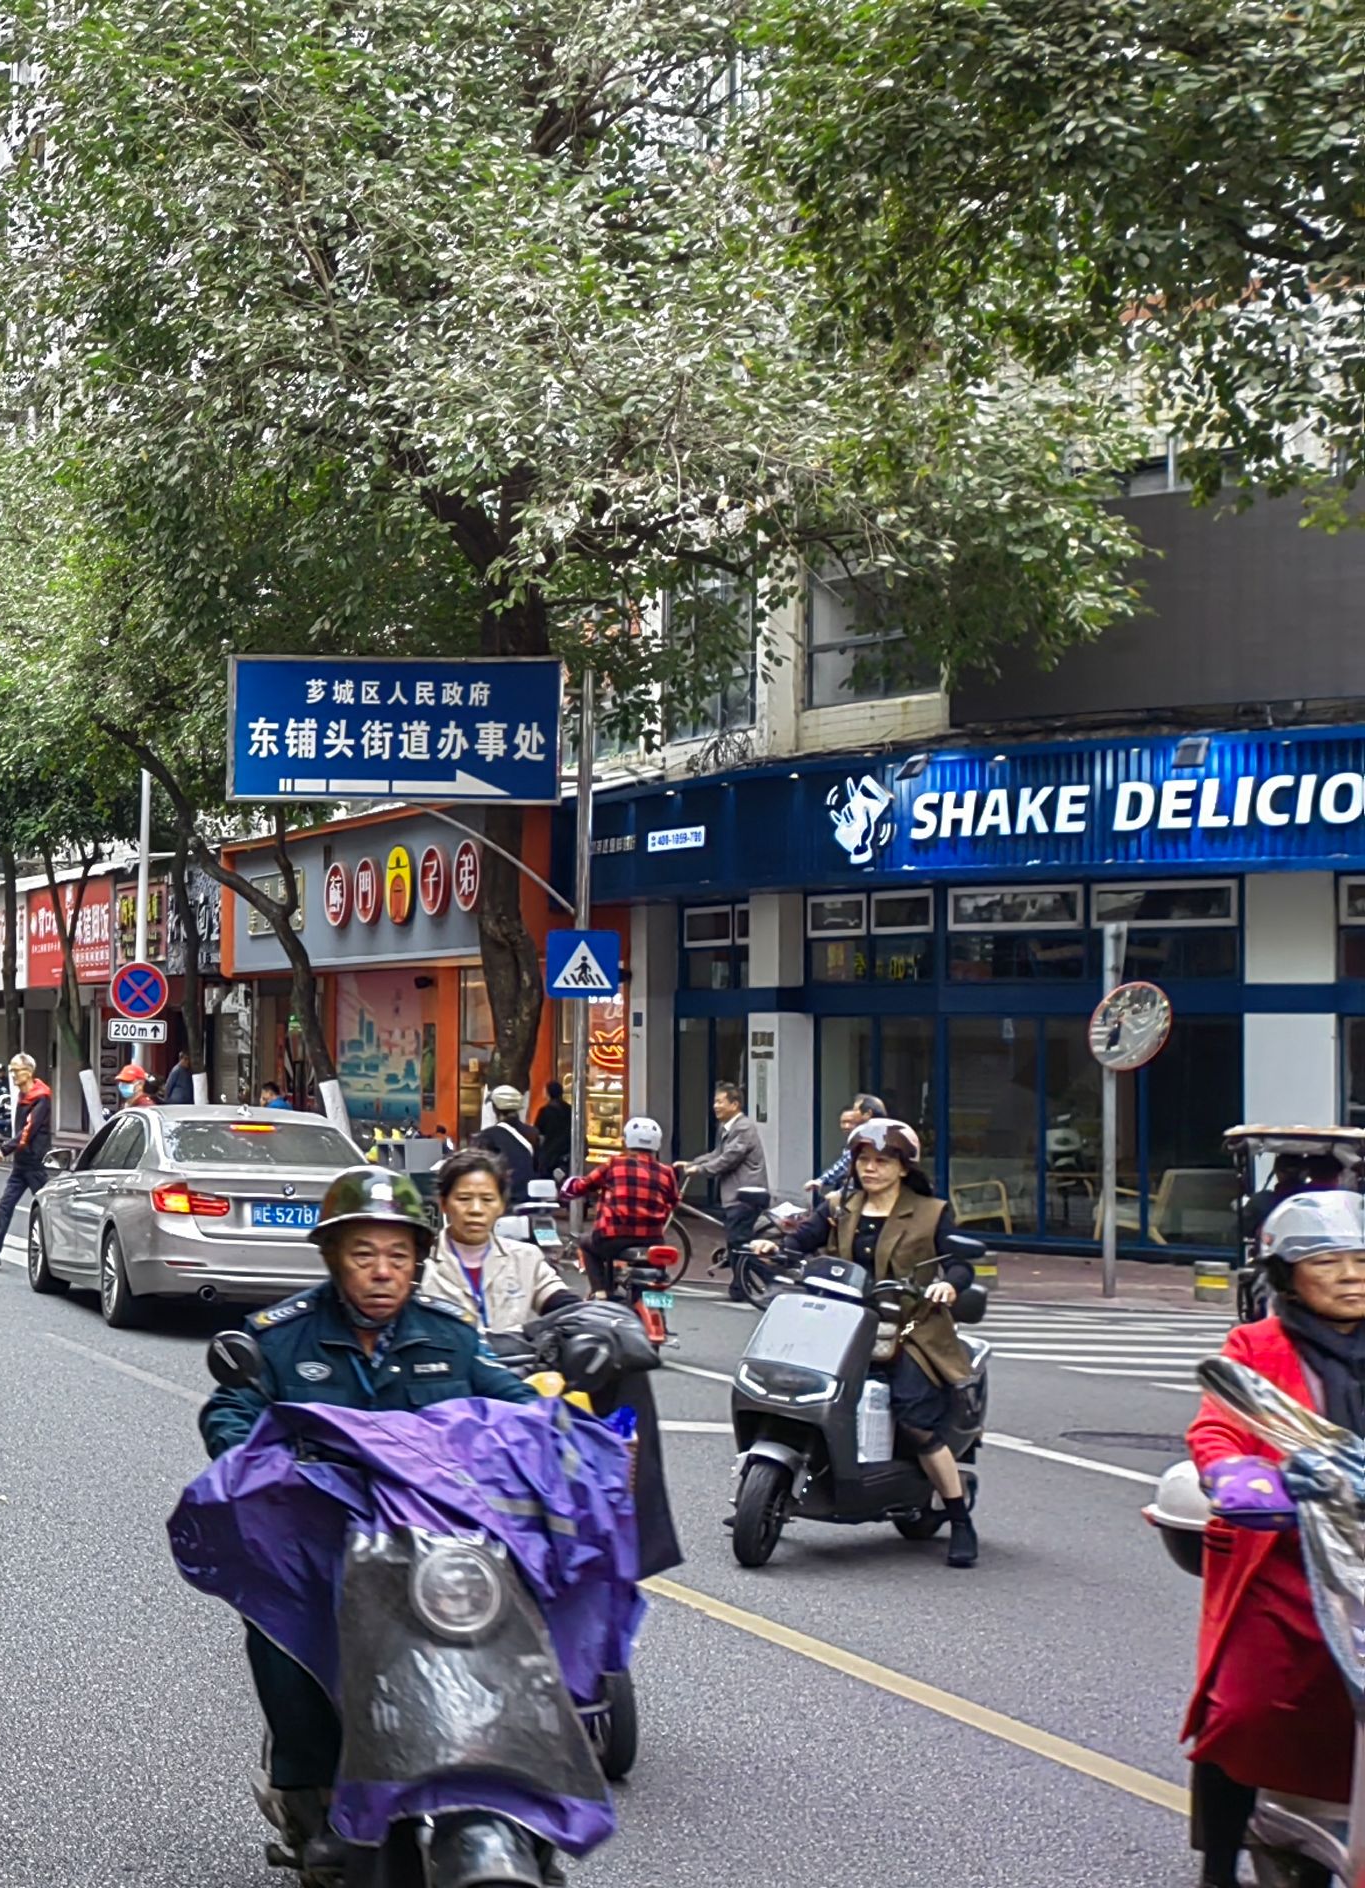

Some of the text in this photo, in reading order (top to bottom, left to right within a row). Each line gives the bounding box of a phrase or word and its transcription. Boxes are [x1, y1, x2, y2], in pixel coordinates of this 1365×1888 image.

[306, 679, 491, 707] 芗城区人民政府
[248, 717, 547, 762] 东铺头街道办事处
[910, 771, 1365, 840] SHAKE DELICIO
[113, 1023, 148, 1037] 200m
